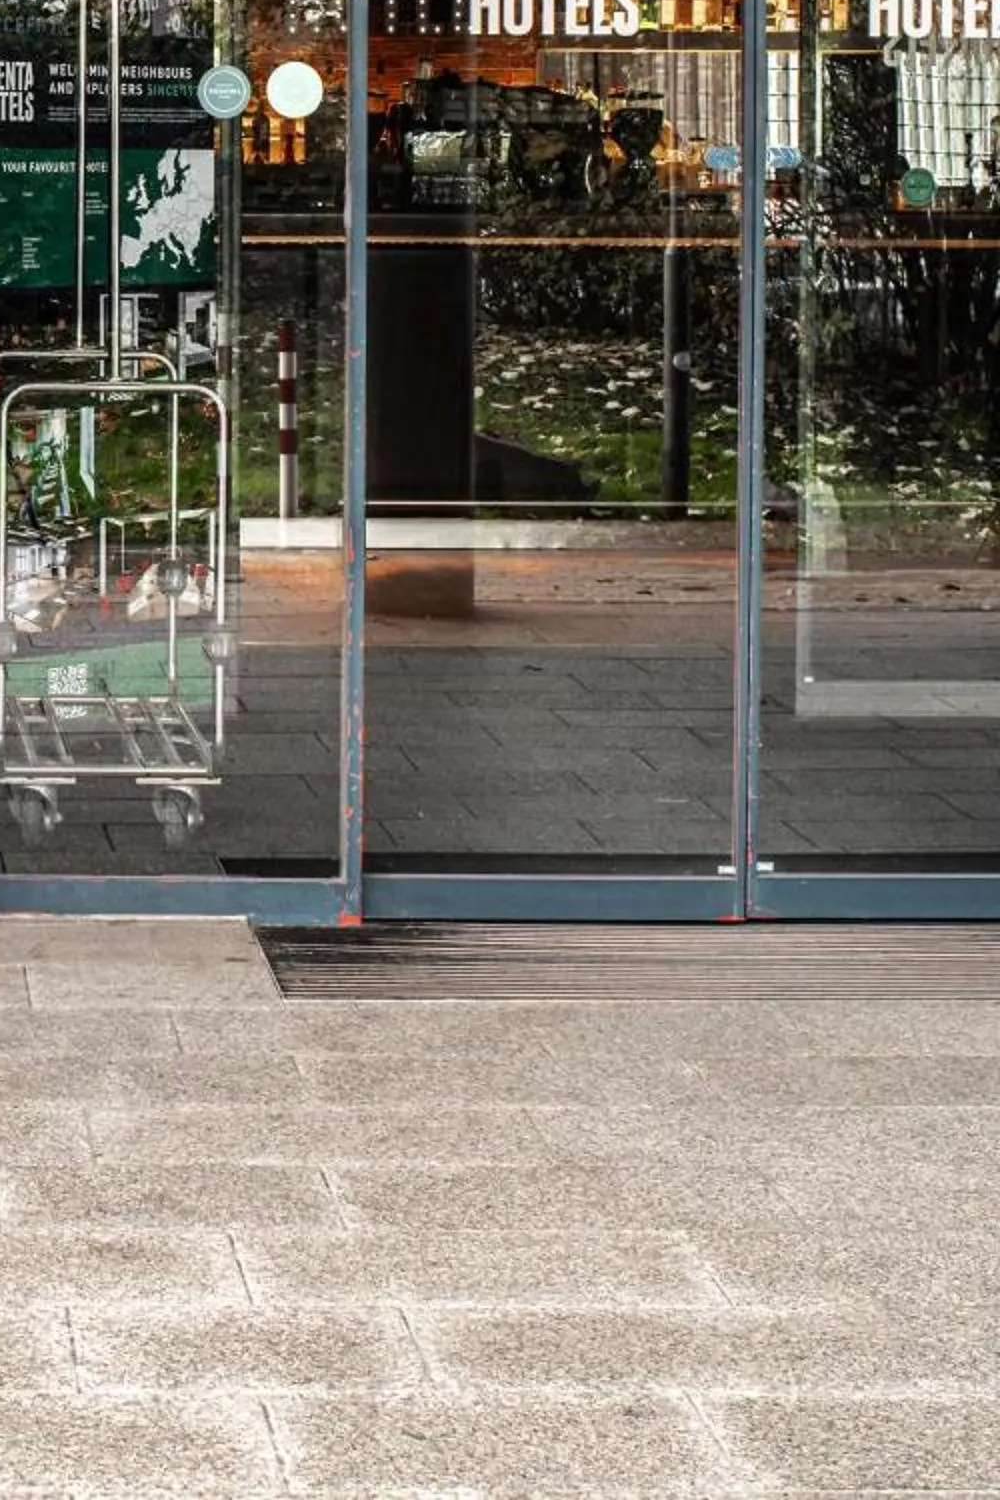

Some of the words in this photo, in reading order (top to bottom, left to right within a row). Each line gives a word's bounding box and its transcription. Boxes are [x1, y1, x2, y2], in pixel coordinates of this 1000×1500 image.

[49, 64, 114, 77] WELMIN
[121, 65, 193, 79] NEIGHBOURS
[49, 81, 74, 95] AND
[1, 161, 27, 173] YOUR
[29, 161, 81, 173] FAVOURIT
